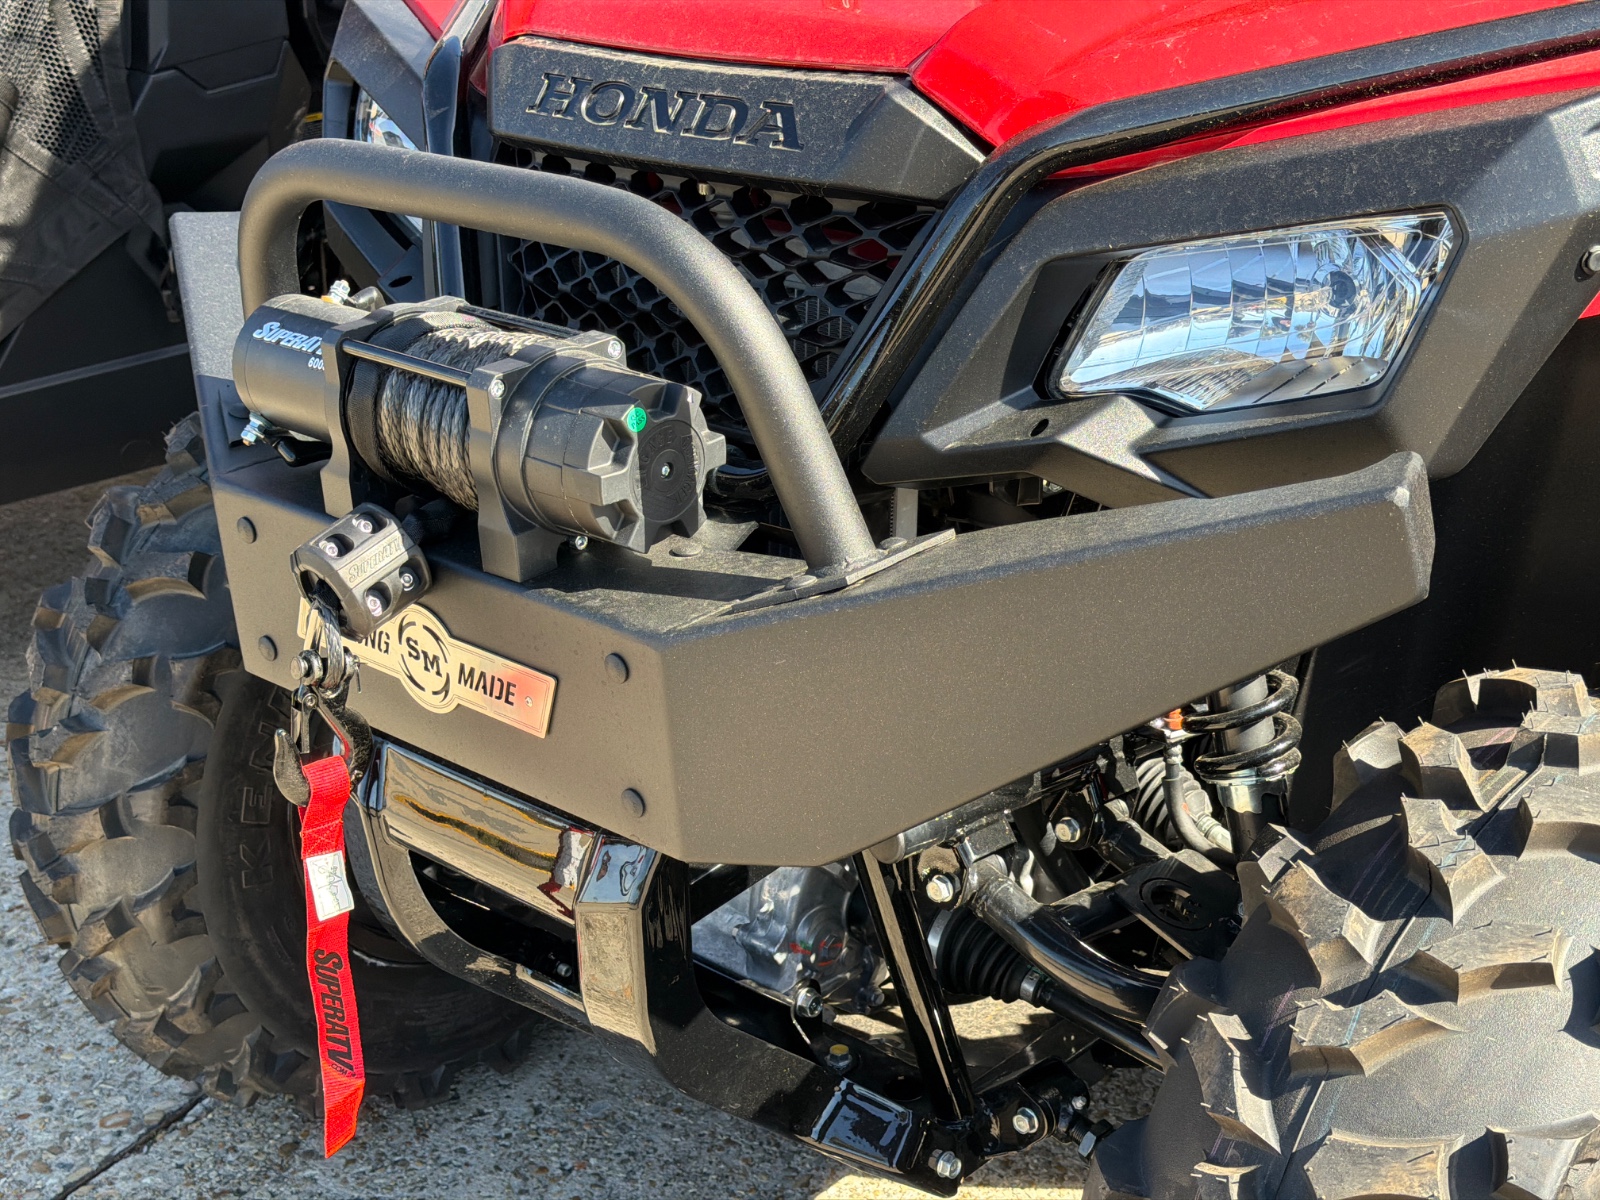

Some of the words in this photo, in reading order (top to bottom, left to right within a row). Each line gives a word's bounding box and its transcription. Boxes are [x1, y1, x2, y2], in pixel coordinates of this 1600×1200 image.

[526, 72, 804, 151] HONDA
[308, 356, 325, 371] 600
[348, 535, 404, 584] SUPERATV
[405, 637, 443, 678] SM
[458, 662, 517, 707] MADE
[313, 949, 354, 1071] SUPERATV
